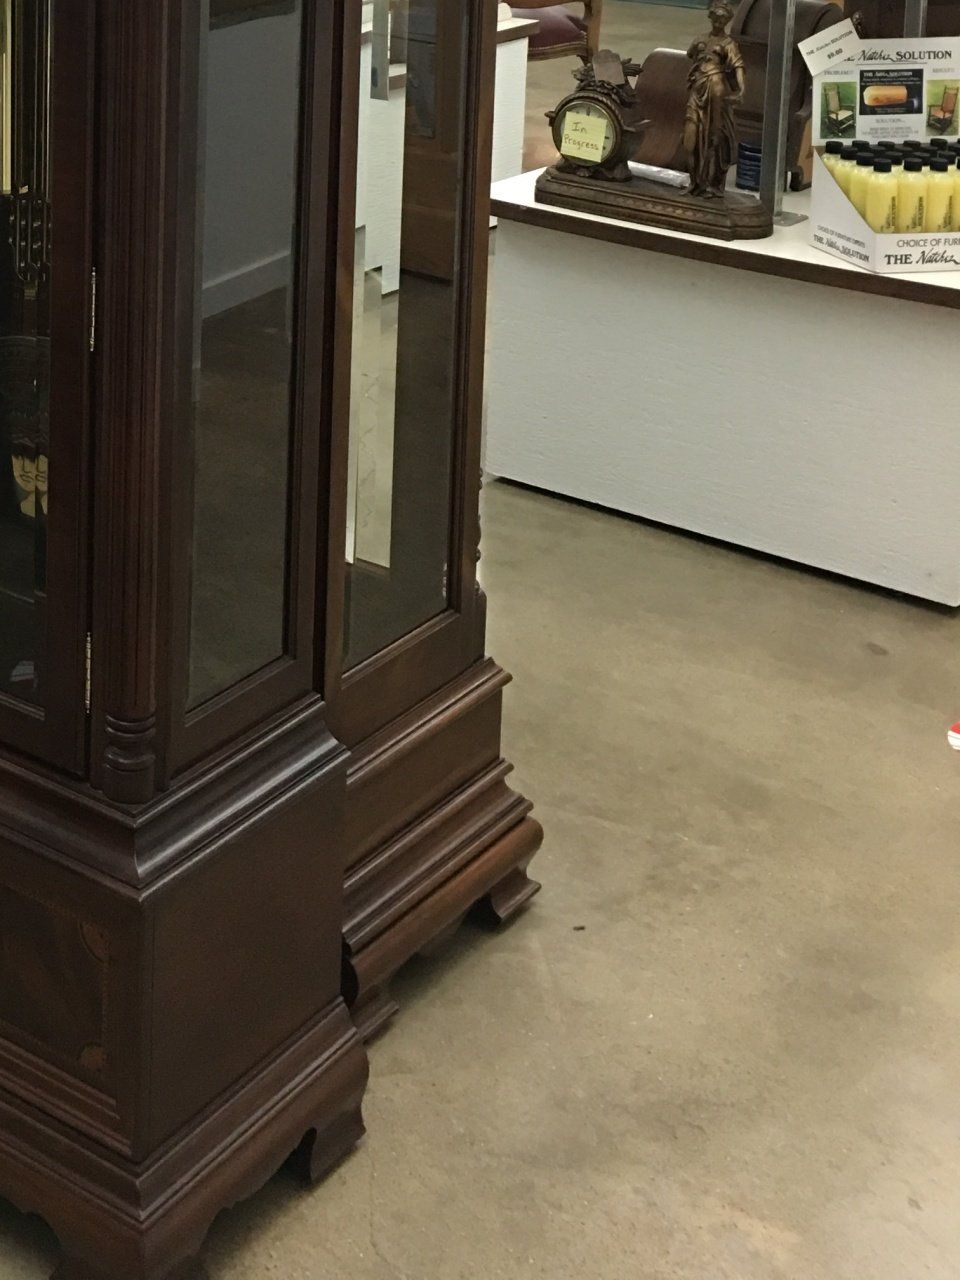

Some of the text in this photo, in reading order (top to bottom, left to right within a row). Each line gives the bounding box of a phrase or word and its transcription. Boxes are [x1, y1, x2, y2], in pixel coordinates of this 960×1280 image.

[896, 50, 952, 61] SOLUTION
[571, 121, 588, 134] In
[564, 133, 599, 150] Progress
[897, 239, 928, 247] CHOICE
[930, 238, 942, 246] OF
[885, 254, 913, 265] THE
